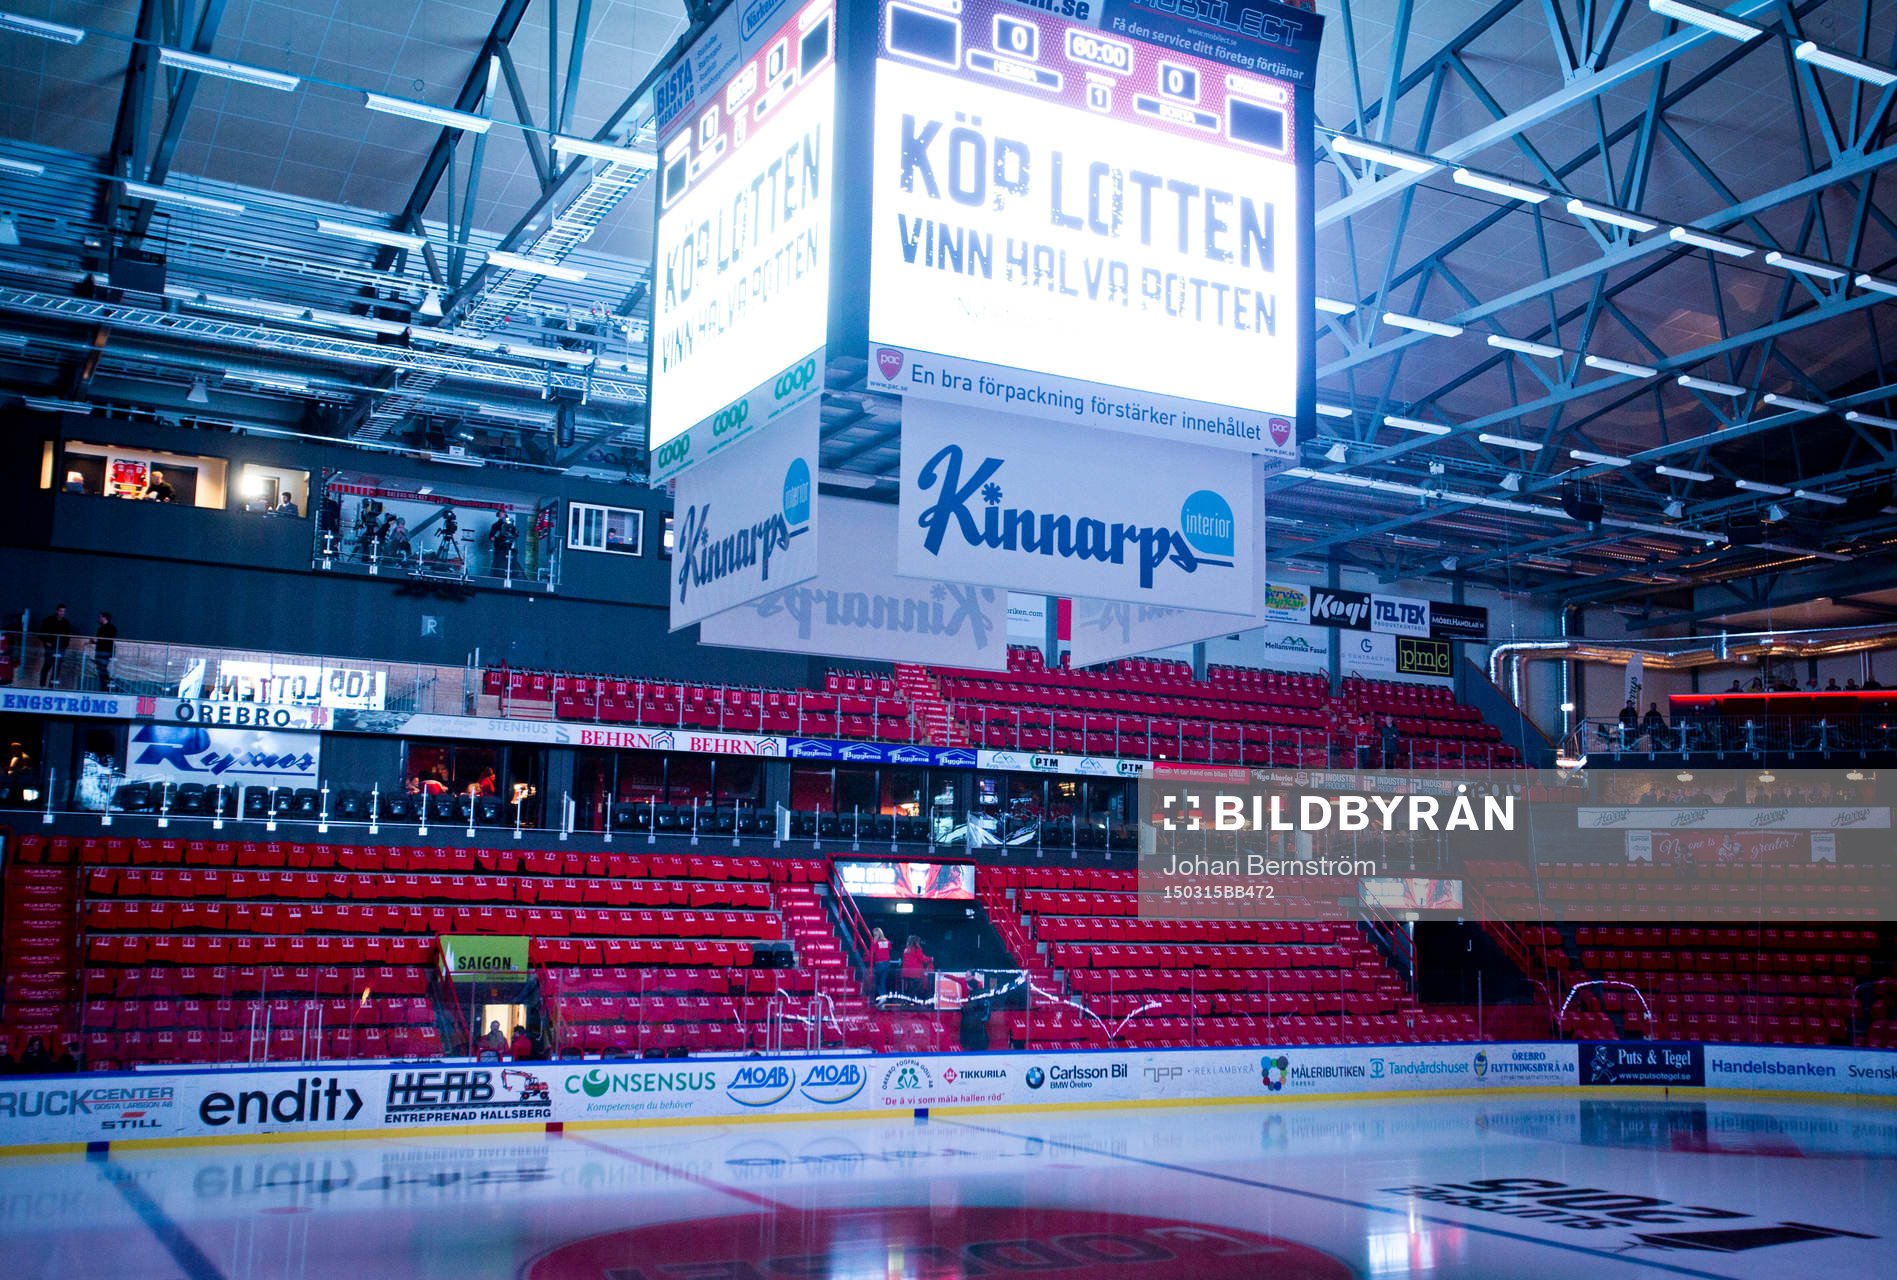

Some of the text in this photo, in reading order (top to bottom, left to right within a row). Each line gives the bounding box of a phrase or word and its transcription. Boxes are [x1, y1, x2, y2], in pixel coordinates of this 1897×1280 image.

[1011, 26, 1028, 50] 0
[1113, 17, 1304, 80] Få den service ditt företag förtjänar
[657, 58, 693, 116] BISTA
[1168, 70, 1183, 93] 0
[900, 111, 1276, 273] KÖP LOTTEN
[898, 213, 1276, 337] VINN HALVA POTTEN
[880, 354, 900, 365] pac
[775, 358, 815, 400] coop
[911, 364, 1261, 441] En bra förpackning förstärker innehållet
[712, 399, 749, 437] coop
[657, 434, 690, 469] coop
[917, 443, 1203, 589] Kinnarps
[1186, 509, 1232, 538] interior
[678, 503, 791, 606] Kinnarps
[1374, 600, 1426, 625] TELTEK
[1265, 641, 1327, 654] Mellansvenska Fasad
[1401, 649, 1448, 669] pmc
[4, 694, 119, 715] ENGSTRÖMS
[175, 698, 291, 728] ÖREBRO
[488, 720, 549, 734] STENHUS
[580, 729, 651, 750] BEHRN
[690, 736, 757, 756] BEHRN
[1036, 755, 1059, 767] PTM
[1121, 762, 1143, 775] PTM
[1325, 774, 1355, 783] INDUSTRI
[1377, 777, 1407, 786] INDUSTRI
[1593, 809, 1631, 827] Harrys
[1671, 809, 1709, 827] Harrys
[1750, 809, 1789, 827] Harrys
[1831, 809, 1871, 827] Harrys
[458, 956, 512, 970] SAIGON
[1512, 1049, 1546, 1061] ÖREBRO
[1617, 1049, 1691, 1067] Puts & Tegel
[801, 1064, 861, 1087] MOAB
[959, 1069, 1007, 1079] TIKKURILA
[1050, 1064, 1128, 1080] Carlsson Bil
[1291, 1063, 1365, 1079] MÅLERIBUTIKEN
[1388, 1060, 1469, 1075] Tandvårdshuset
[1491, 1060, 1575, 1073] FLYTTNINGSBYRÅ AB
[1712, 1059, 1836, 1077] Handelsbanken
[565, 1069, 716, 1098] CONSENSUS
[727, 1067, 790, 1089] MOAB
[1050, 1079, 1093, 1089] BMW Örebro
[92, 1087, 174, 1100] CENTER
[387, 1070, 495, 1105] HEAB
[122, 1101, 160, 1110] LARSSON
[586, 1100, 694, 1113] Kompetensen du behöver
[907, 1096, 916, 1104] vi
[918, 1097, 936, 1105] som
[960, 1093, 986, 1102] hallen
[101, 1119, 162, 1130] STILL
[384, 1108, 552, 1124] ENTREPRENAD HALLSBERG
